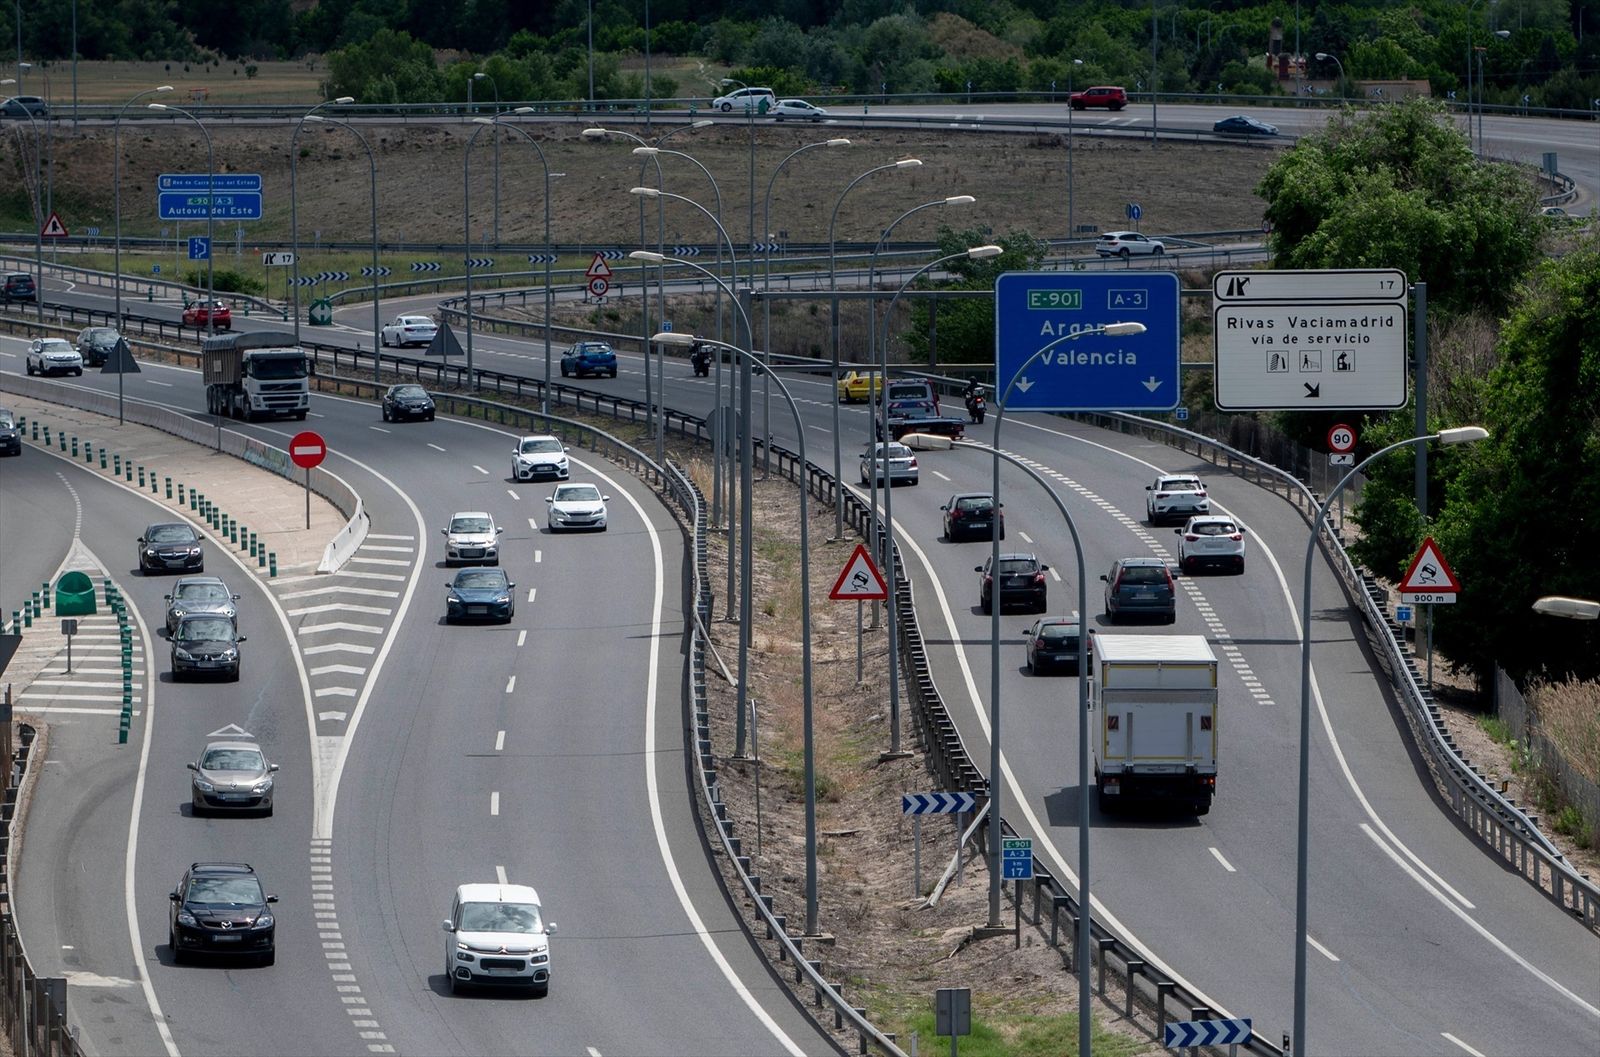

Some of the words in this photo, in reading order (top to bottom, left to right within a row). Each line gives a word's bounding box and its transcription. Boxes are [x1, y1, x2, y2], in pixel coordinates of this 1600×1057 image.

[168, 207, 207, 215] Autovía
[282, 254, 292, 263] 17
[593, 282, 605, 290] 60
[1380, 281, 1394, 290] 17
[1031, 293, 1079, 306] E-901
[1114, 293, 1142, 305] A-3
[1227, 317, 1274, 329] Rivas
[1288, 315, 1393, 328] Vaciamadrid
[1040, 320, 1135, 340] Argan
[1251, 334, 1273, 345] vía
[1282, 334, 1298, 344] de
[1308, 333, 1370, 344] servicio
[1040, 349, 1137, 365] Valencia
[1334, 434, 1350, 444] 90
[1414, 594, 1433, 602] 900
[1011, 867, 1024, 877] 17
